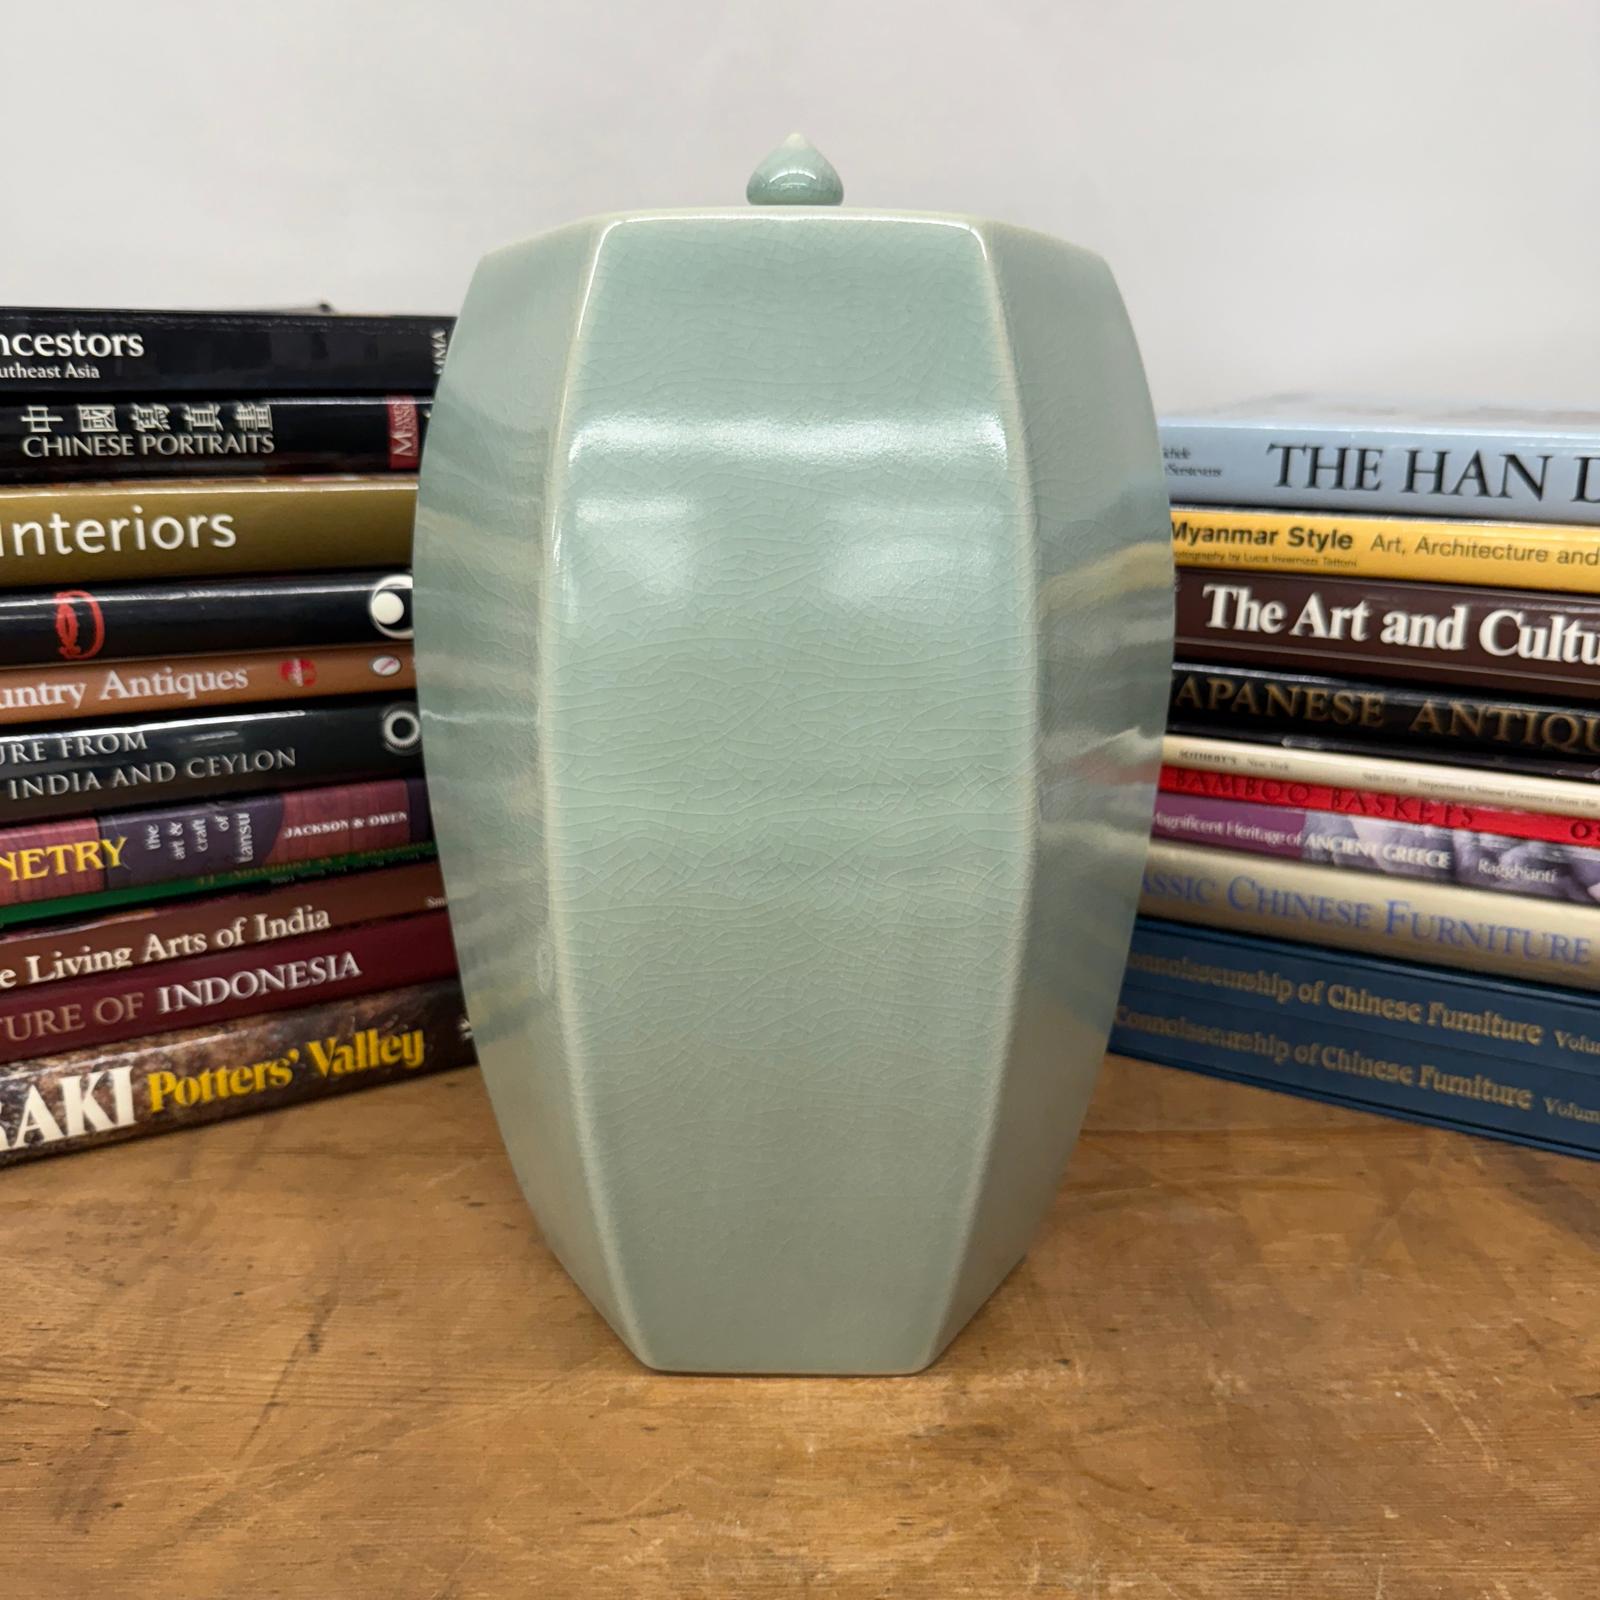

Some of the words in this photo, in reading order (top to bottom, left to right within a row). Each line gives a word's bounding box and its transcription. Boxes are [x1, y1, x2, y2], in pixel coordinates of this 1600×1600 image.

[0, 329, 145, 357] ncestors
[0, 362, 62, 379] utheast
[65, 361, 101, 379] Asia
[22, 434, 136, 457] CHINESE
[143, 432, 275, 456] PORTRAITS
[1266, 443, 1384, 491] THE
[1400, 450, 1553, 502] HAN
[1171, 521, 1279, 546] Myanmar
[1287, 526, 1354, 551] Style
[1370, 534, 1406, 556] Art,
[1414, 536, 1549, 563] Architecture
[1557, 547, 1600, 566] and
[1202, 583, 1288, 635] The
[1289, 591, 1373, 642] Art
[1380, 603, 1470, 651] and
[1479, 609, 1600, 666] Cultu
[100, 666, 249, 700] Antiques
[1172, 674, 1385, 729] APANESE
[59, 731, 148, 759] FROM
[9, 770, 102, 800] INDIA
[111, 761, 177, 789] AND
[186, 747, 296, 779] CEYLON
[283, 818, 349, 839] JACKSON
[352, 817, 366, 828] &
[369, 811, 408, 827] OWEN
[1174, 768, 1312, 803] BAMBOO
[1330, 787, 1474, 827] BASKETS
[1570, 821, 1600, 842] O
[0, 836, 128, 881] NETRY
[1226, 820, 1286, 848] Heritage
[1286, 830, 1302, 846] of
[1304, 833, 1378, 859] ANCIENT
[1383, 844, 1450, 869] GREECE
[25, 945, 133, 984] Living
[142, 932, 208, 963] Arts
[215, 917, 248, 948] of
[254, 904, 332, 942] India
[1227, 875, 1372, 930] CHINESE
[1383, 898, 1592, 966] FURNITURE
[0, 1003, 86, 1041] URE
[93, 992, 145, 1025] OF
[155, 950, 364, 1014] INDONESIA
[1297, 979, 1326, 1005] of
[1327, 983, 1423, 1025] Chinese
[1426, 1000, 1544, 1046] Furniture
[1553, 1028, 1600, 1057] Volu
[147, 1047, 300, 1113] Potters'
[306, 1027, 425, 1079] Valley
[1294, 1042, 1321, 1066] of
[1321, 1045, 1414, 1087] Chinese
[1418, 1064, 1535, 1111] Furniture
